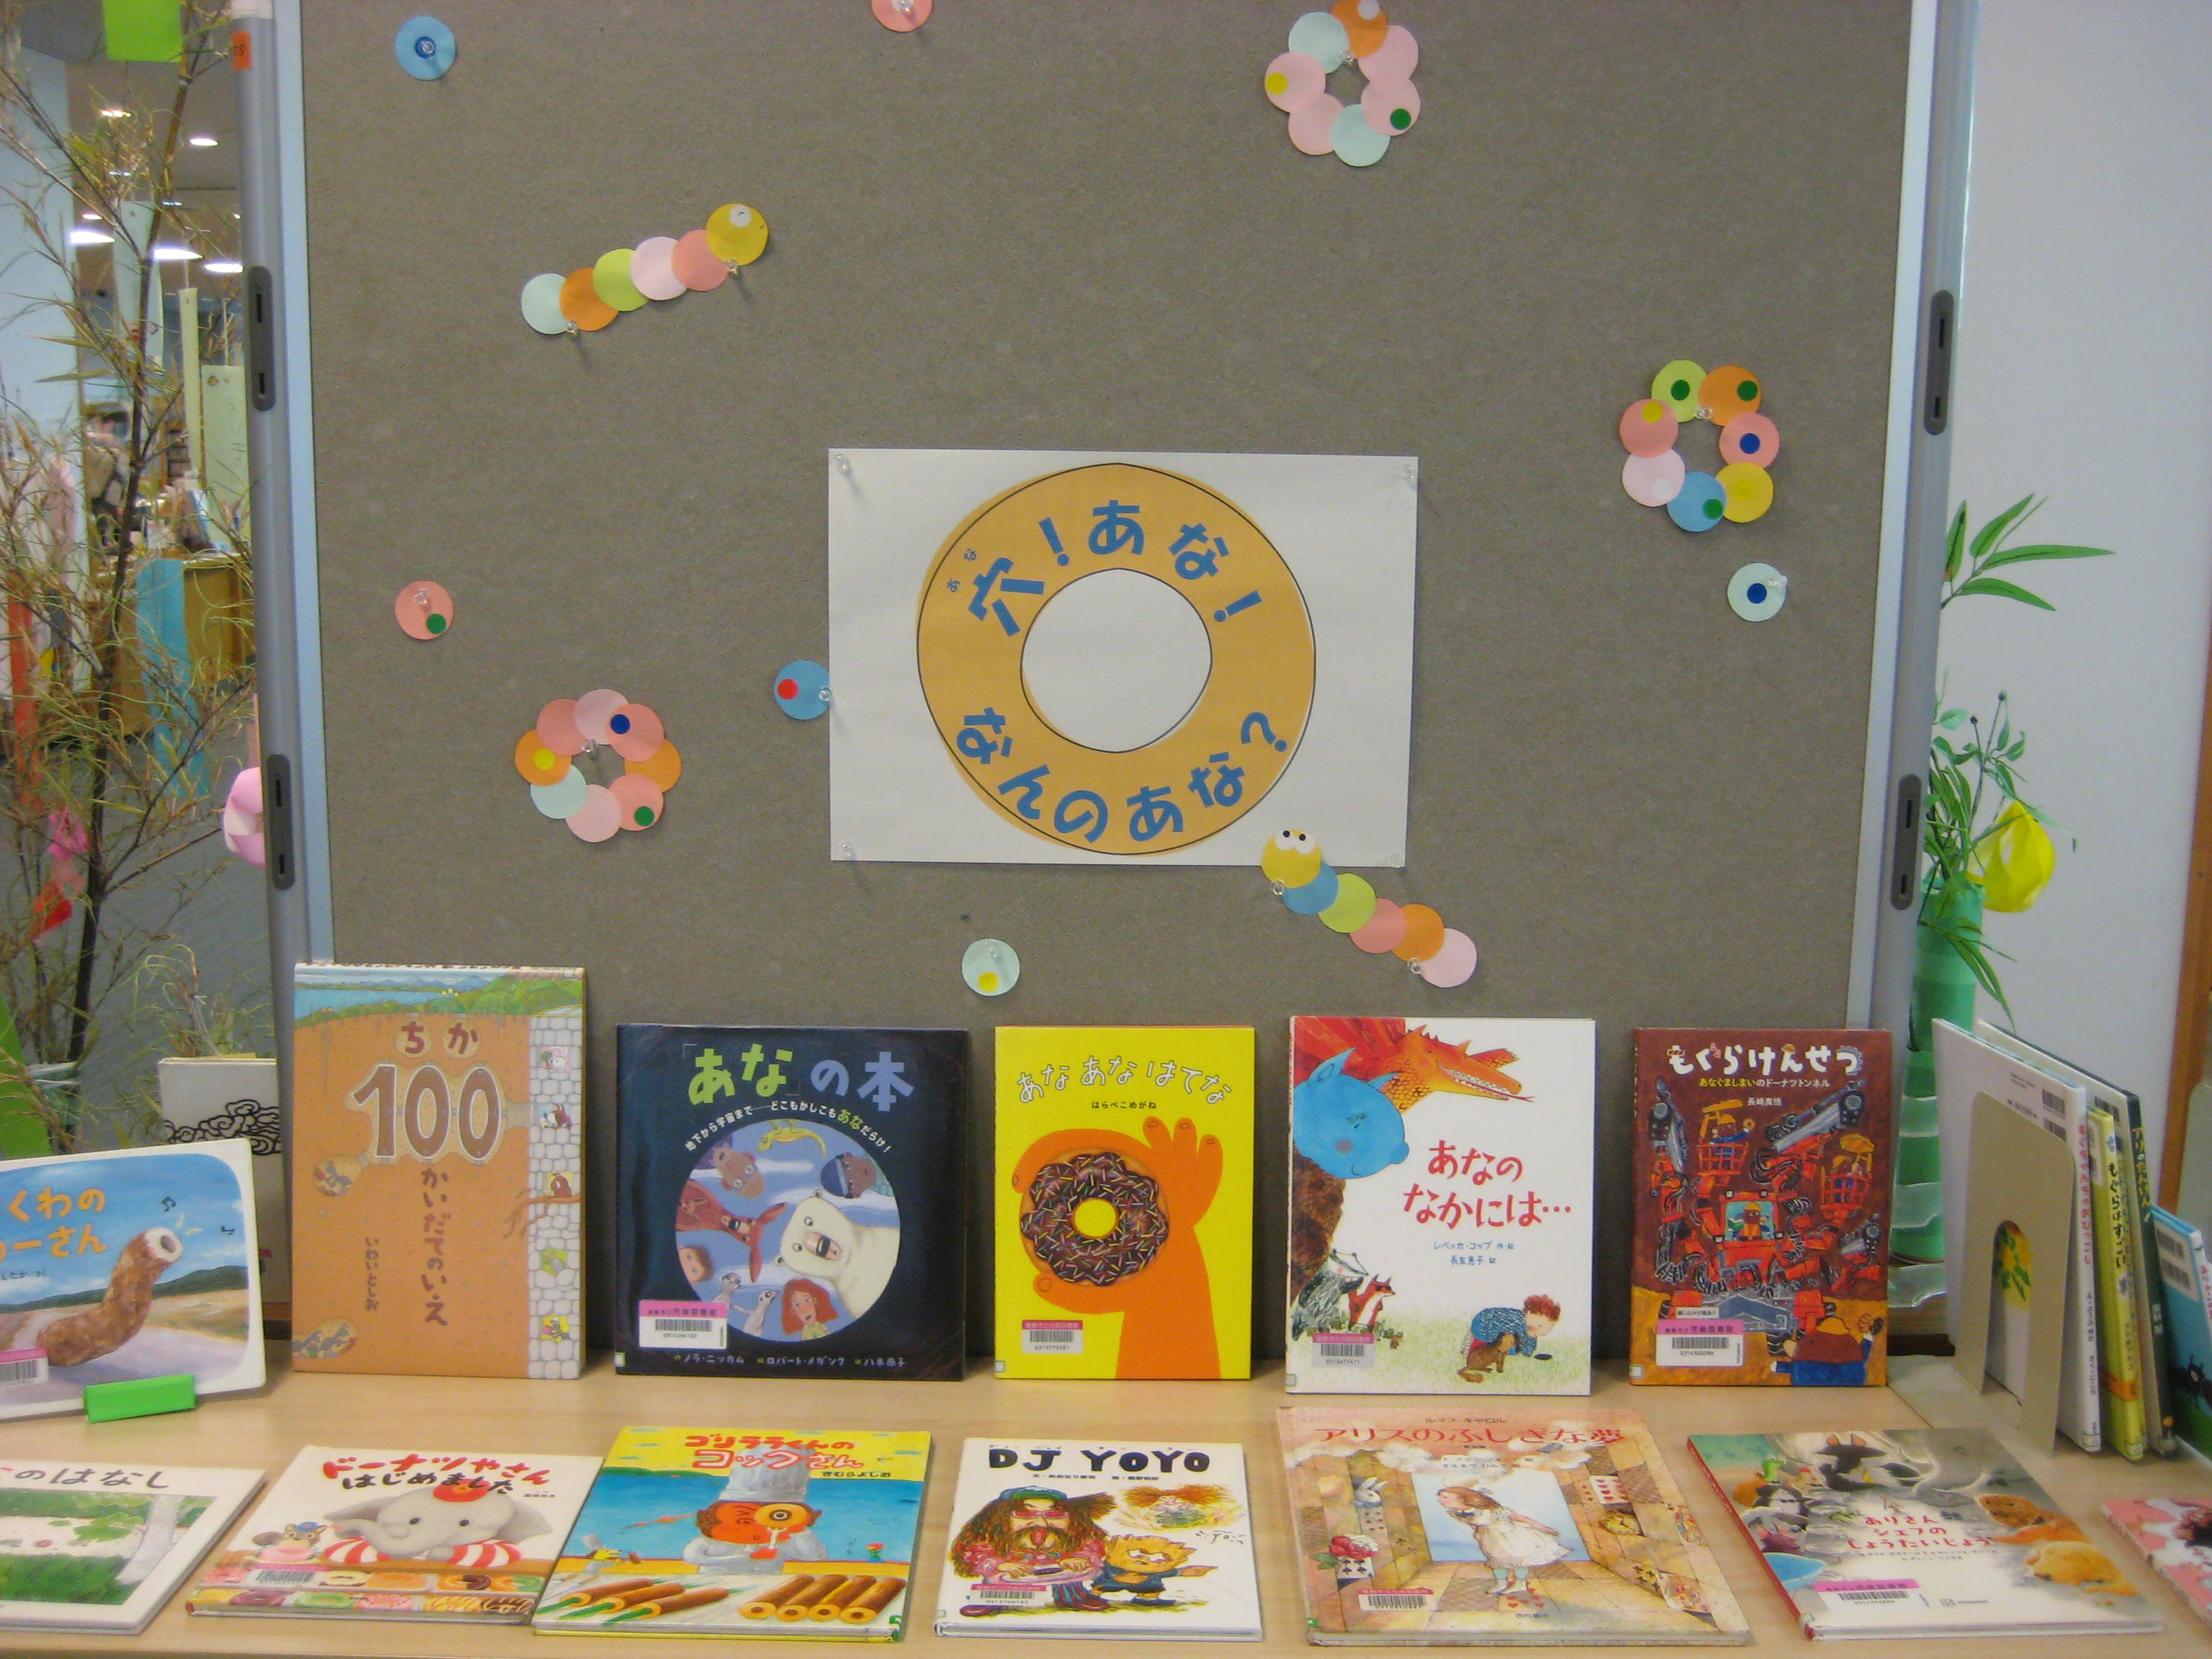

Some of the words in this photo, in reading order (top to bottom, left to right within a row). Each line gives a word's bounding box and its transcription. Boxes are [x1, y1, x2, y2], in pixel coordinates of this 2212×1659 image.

[956, 707, 1287, 843] なんのあな？
[400, 1021, 478, 1054] ちか
[1666, 1042, 1863, 1076] もぐらけんせつ
[351, 1064, 502, 1161] 100
[1427, 1139, 1524, 1186] あなの
[421, 1167, 451, 1326] かいだてのいえ
[1314, 1427, 1626, 1444] アリスのふしぎな夢
[322, 1453, 551, 1486] ドーナツやさん
[692, 1449, 865, 1470] コックさん
[989, 1449, 1062, 1471] DJ
[1080, 1449, 1210, 1473] YOYO
[341, 1472, 514, 1495] はじめました
